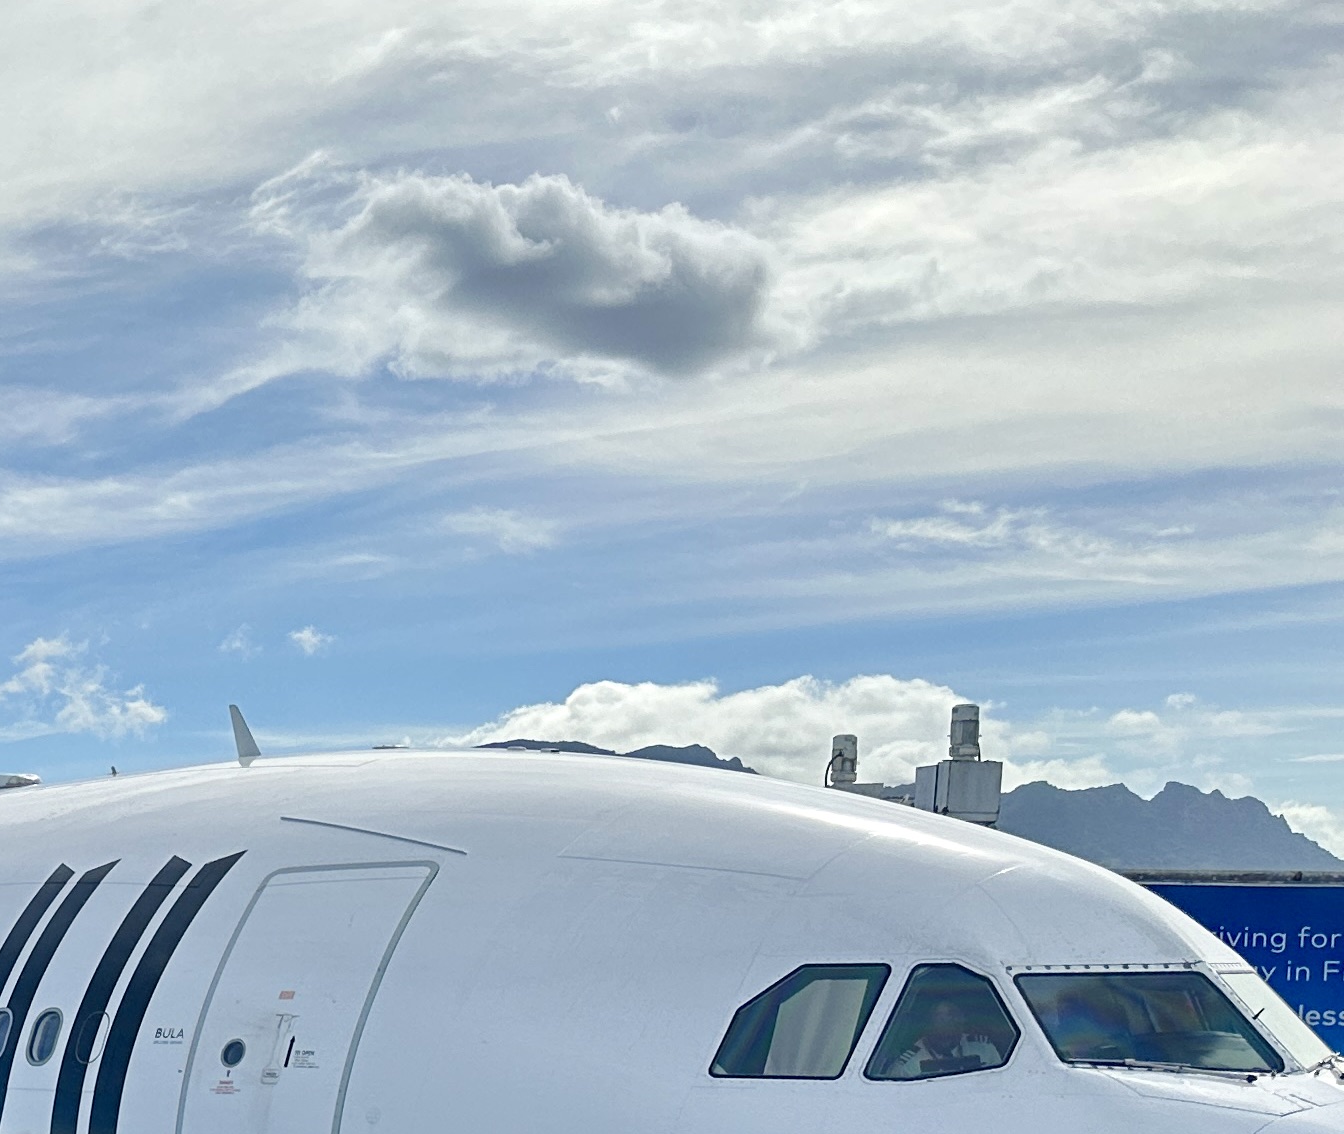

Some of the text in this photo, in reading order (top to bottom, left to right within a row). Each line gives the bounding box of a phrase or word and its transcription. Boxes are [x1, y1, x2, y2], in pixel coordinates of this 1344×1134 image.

[1213, 926, 1342, 953] iving for
[1287, 960, 1310, 981] in
[1324, 960, 1344, 981] F
[154, 1027, 184, 1039] BULA
